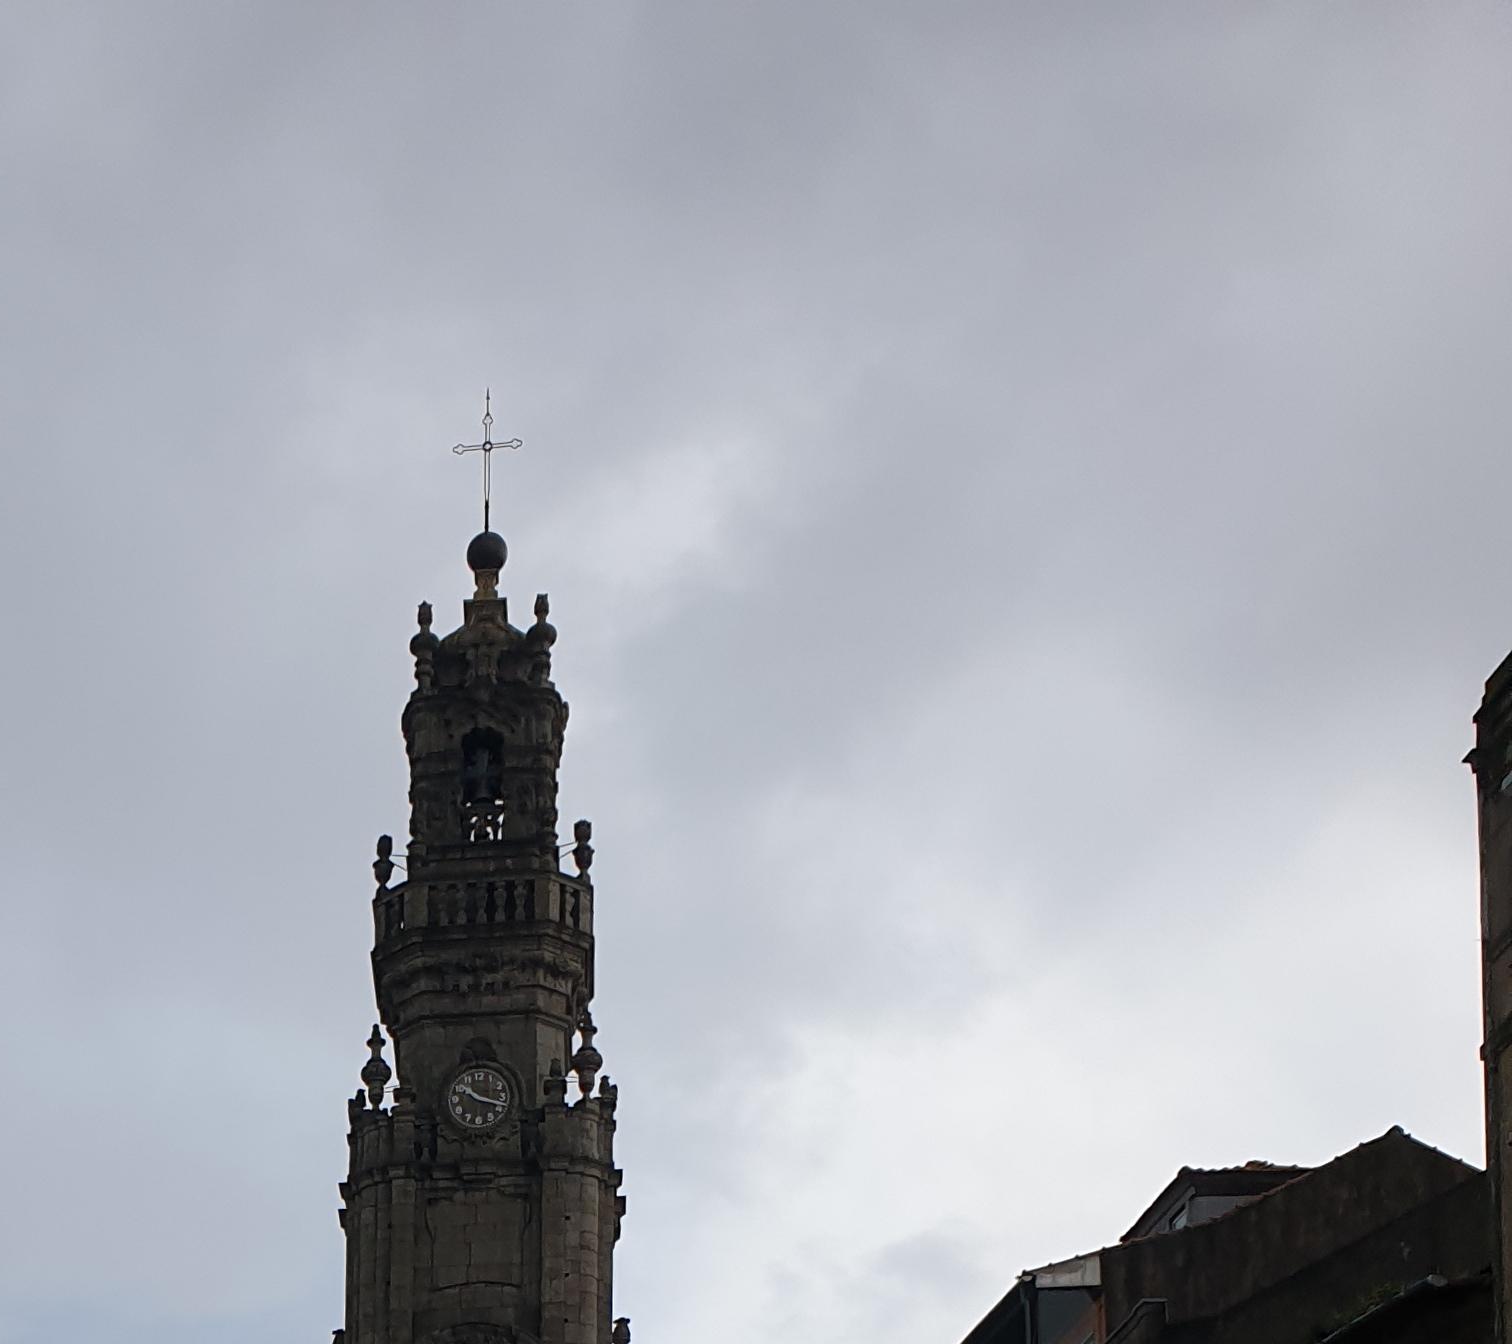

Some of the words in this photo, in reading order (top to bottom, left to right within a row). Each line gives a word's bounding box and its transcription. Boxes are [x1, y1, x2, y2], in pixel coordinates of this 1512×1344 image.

[464, 1075, 472, 1084] 11
[474, 1072, 485, 1081] 12
[488, 1074, 493, 1083] 1
[496, 1081, 503, 1090] 2
[451, 1095, 459, 1104] 9
[498, 1092, 506, 1102] 3
[464, 1113, 472, 1122] 7
